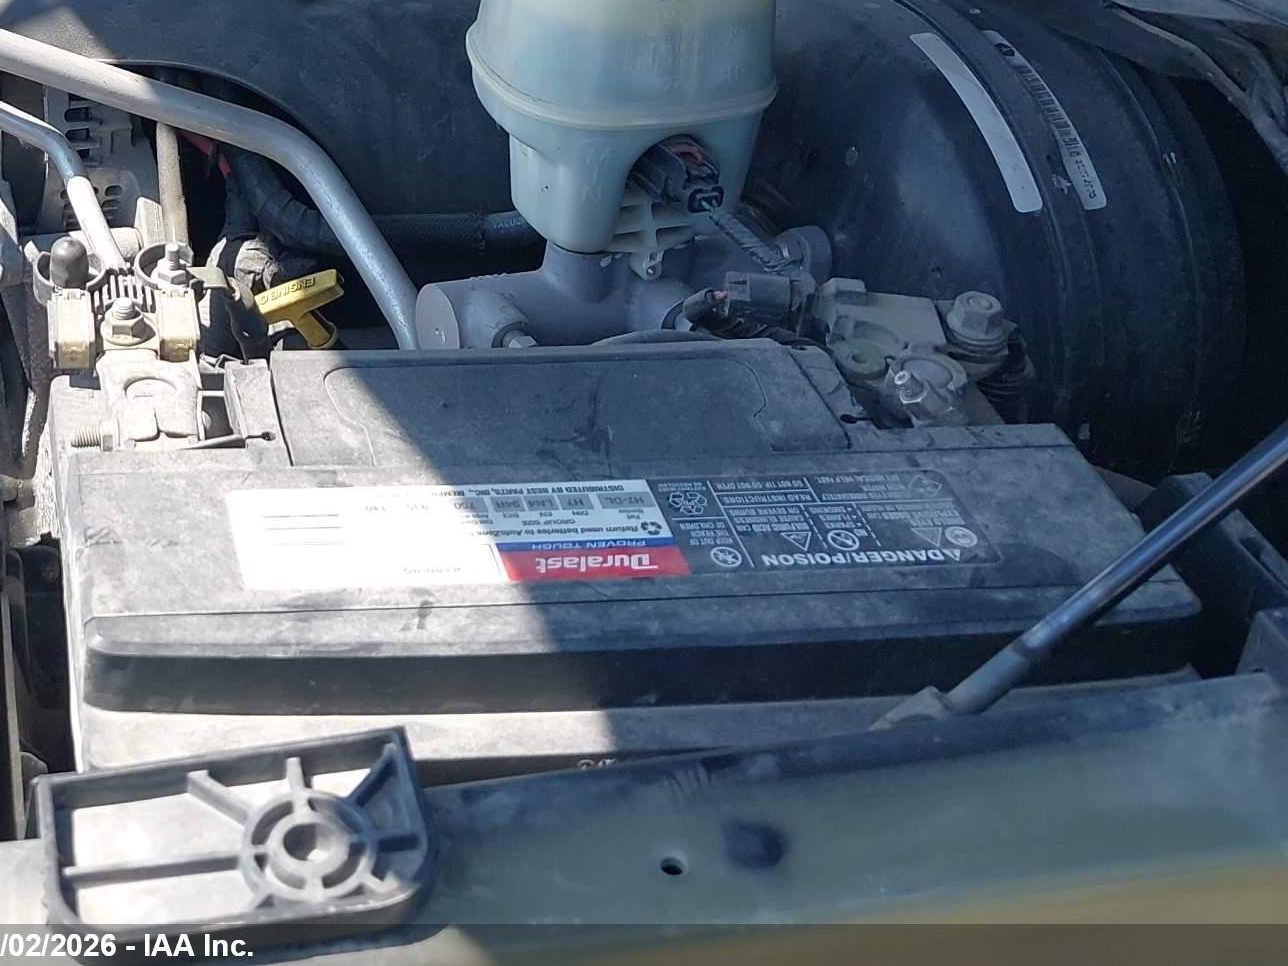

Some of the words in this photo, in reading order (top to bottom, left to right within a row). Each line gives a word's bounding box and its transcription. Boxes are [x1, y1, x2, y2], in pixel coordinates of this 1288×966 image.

[271, 277, 315, 300] ENGINE
[565, 485, 624, 493] DISTRIBUTED
[567, 498, 585, 506] H7
[723, 495, 786, 504] INSTRUCTIONS
[454, 502, 474, 510] 750
[586, 540, 646, 548] PROVEN
[761, 549, 945, 566] DANGER/POISON
[535, 554, 659, 573] Duralast
